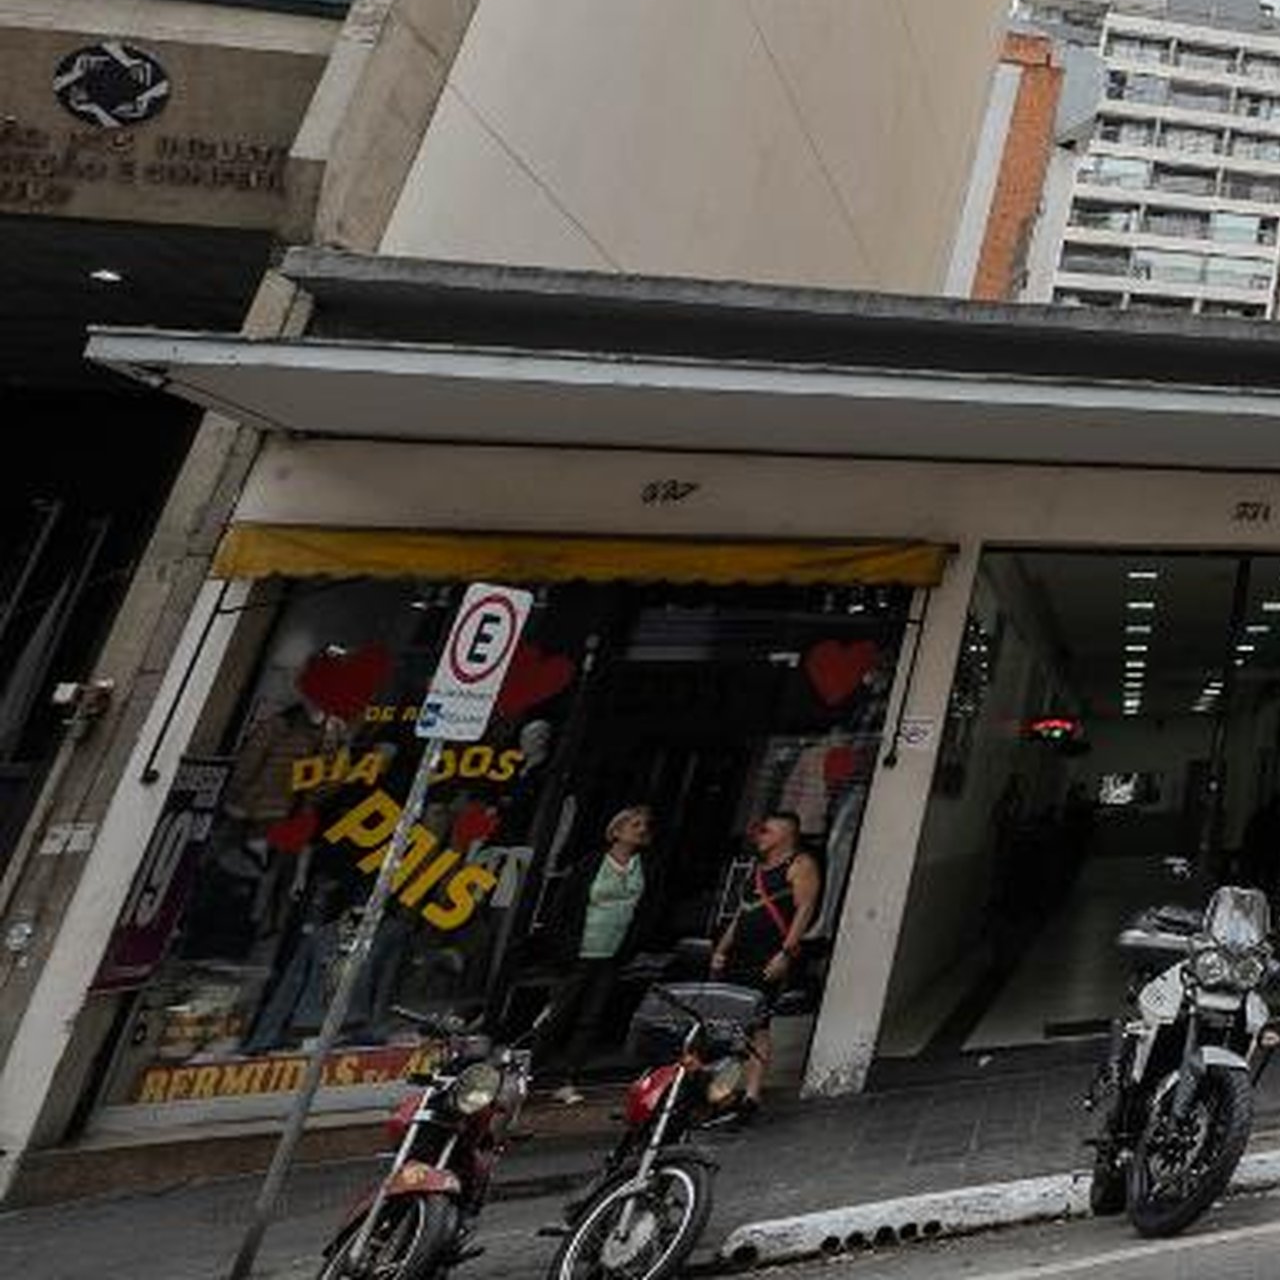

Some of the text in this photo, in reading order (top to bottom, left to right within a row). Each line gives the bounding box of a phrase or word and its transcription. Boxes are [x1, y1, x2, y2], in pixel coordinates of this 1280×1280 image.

[466, 612, 503, 664] E
[292, 745, 524, 792] DIA DOS
[322, 789, 498, 931] PAIS
[137, 1054, 359, 1104] BERMUDS
